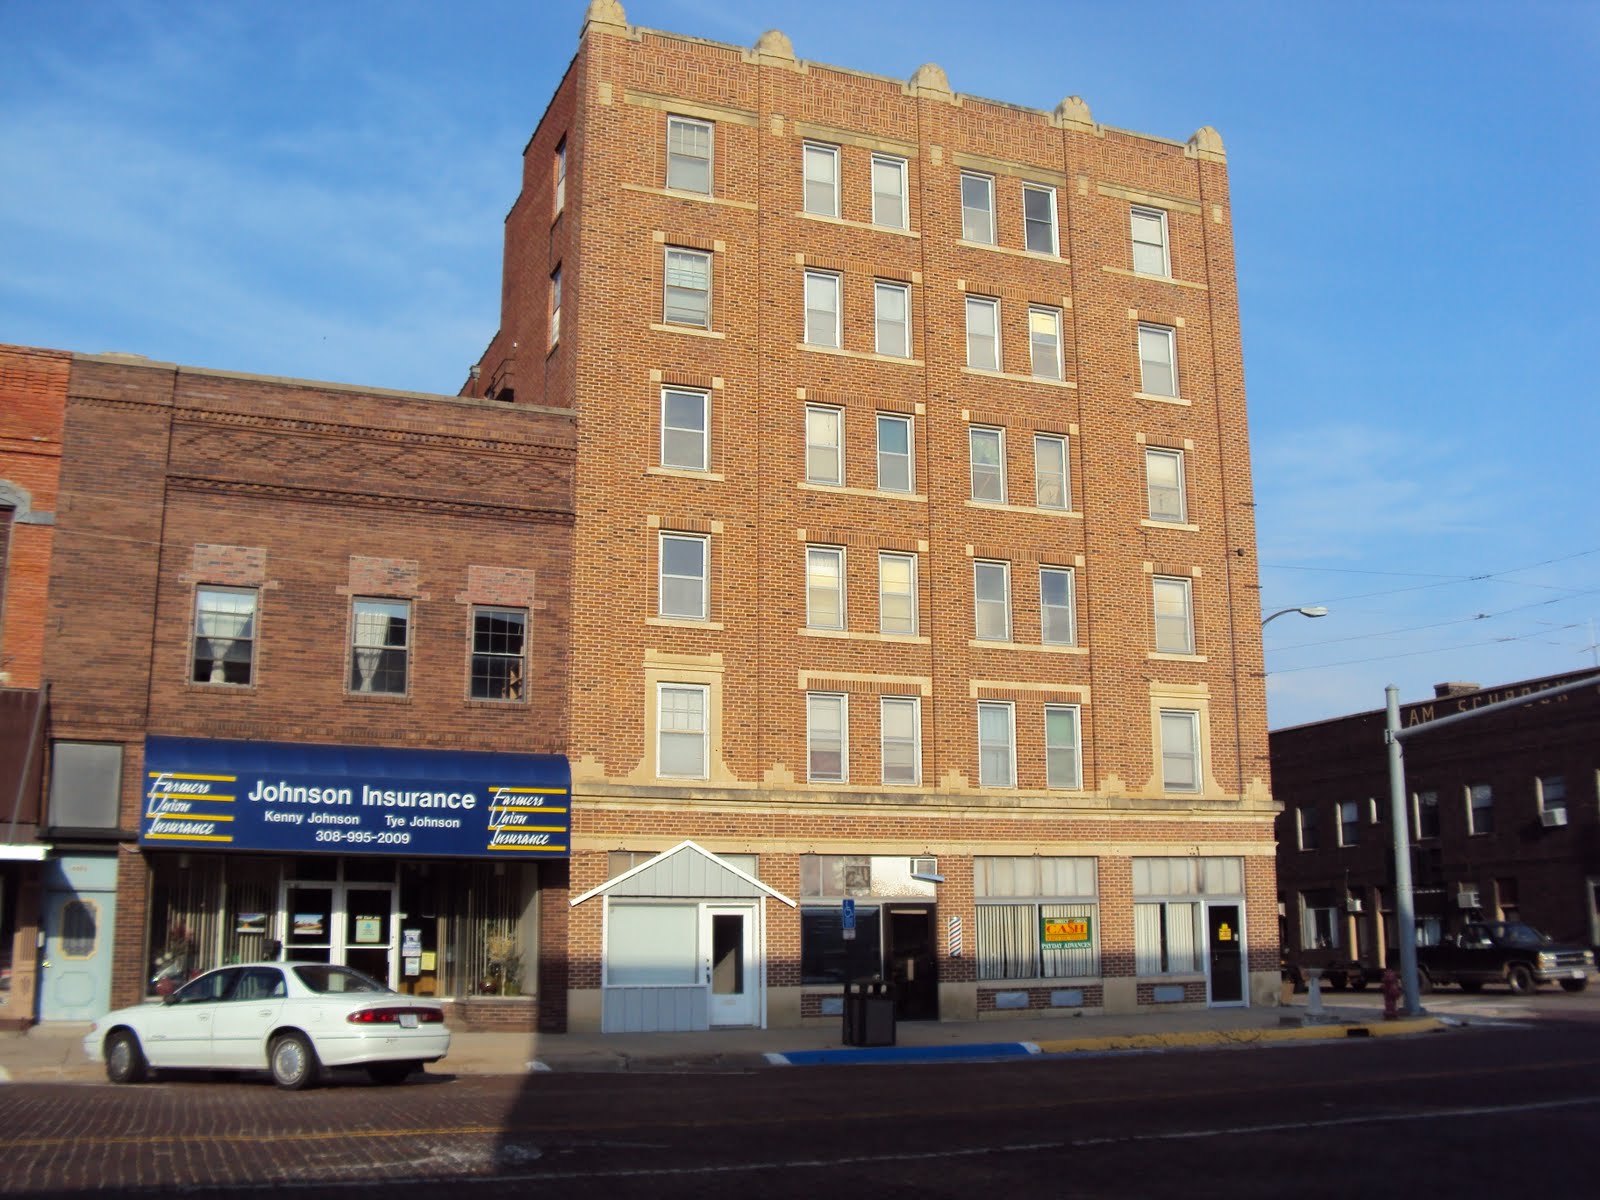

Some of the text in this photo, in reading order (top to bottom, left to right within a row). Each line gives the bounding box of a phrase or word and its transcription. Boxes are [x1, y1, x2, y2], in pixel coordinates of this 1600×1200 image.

[151, 773, 211, 794] Farmers
[148, 793, 192, 814] Union
[248, 780, 476, 809] Johnson Insurance
[491, 787, 544, 807] Farmers
[147, 812, 216, 836] Insurance
[264, 810, 461, 829] Kenny Johnson Tye Johnson
[489, 806, 528, 828] Union
[315, 830, 411, 844] 308-995-2009
[490, 824, 550, 847] Insurance
